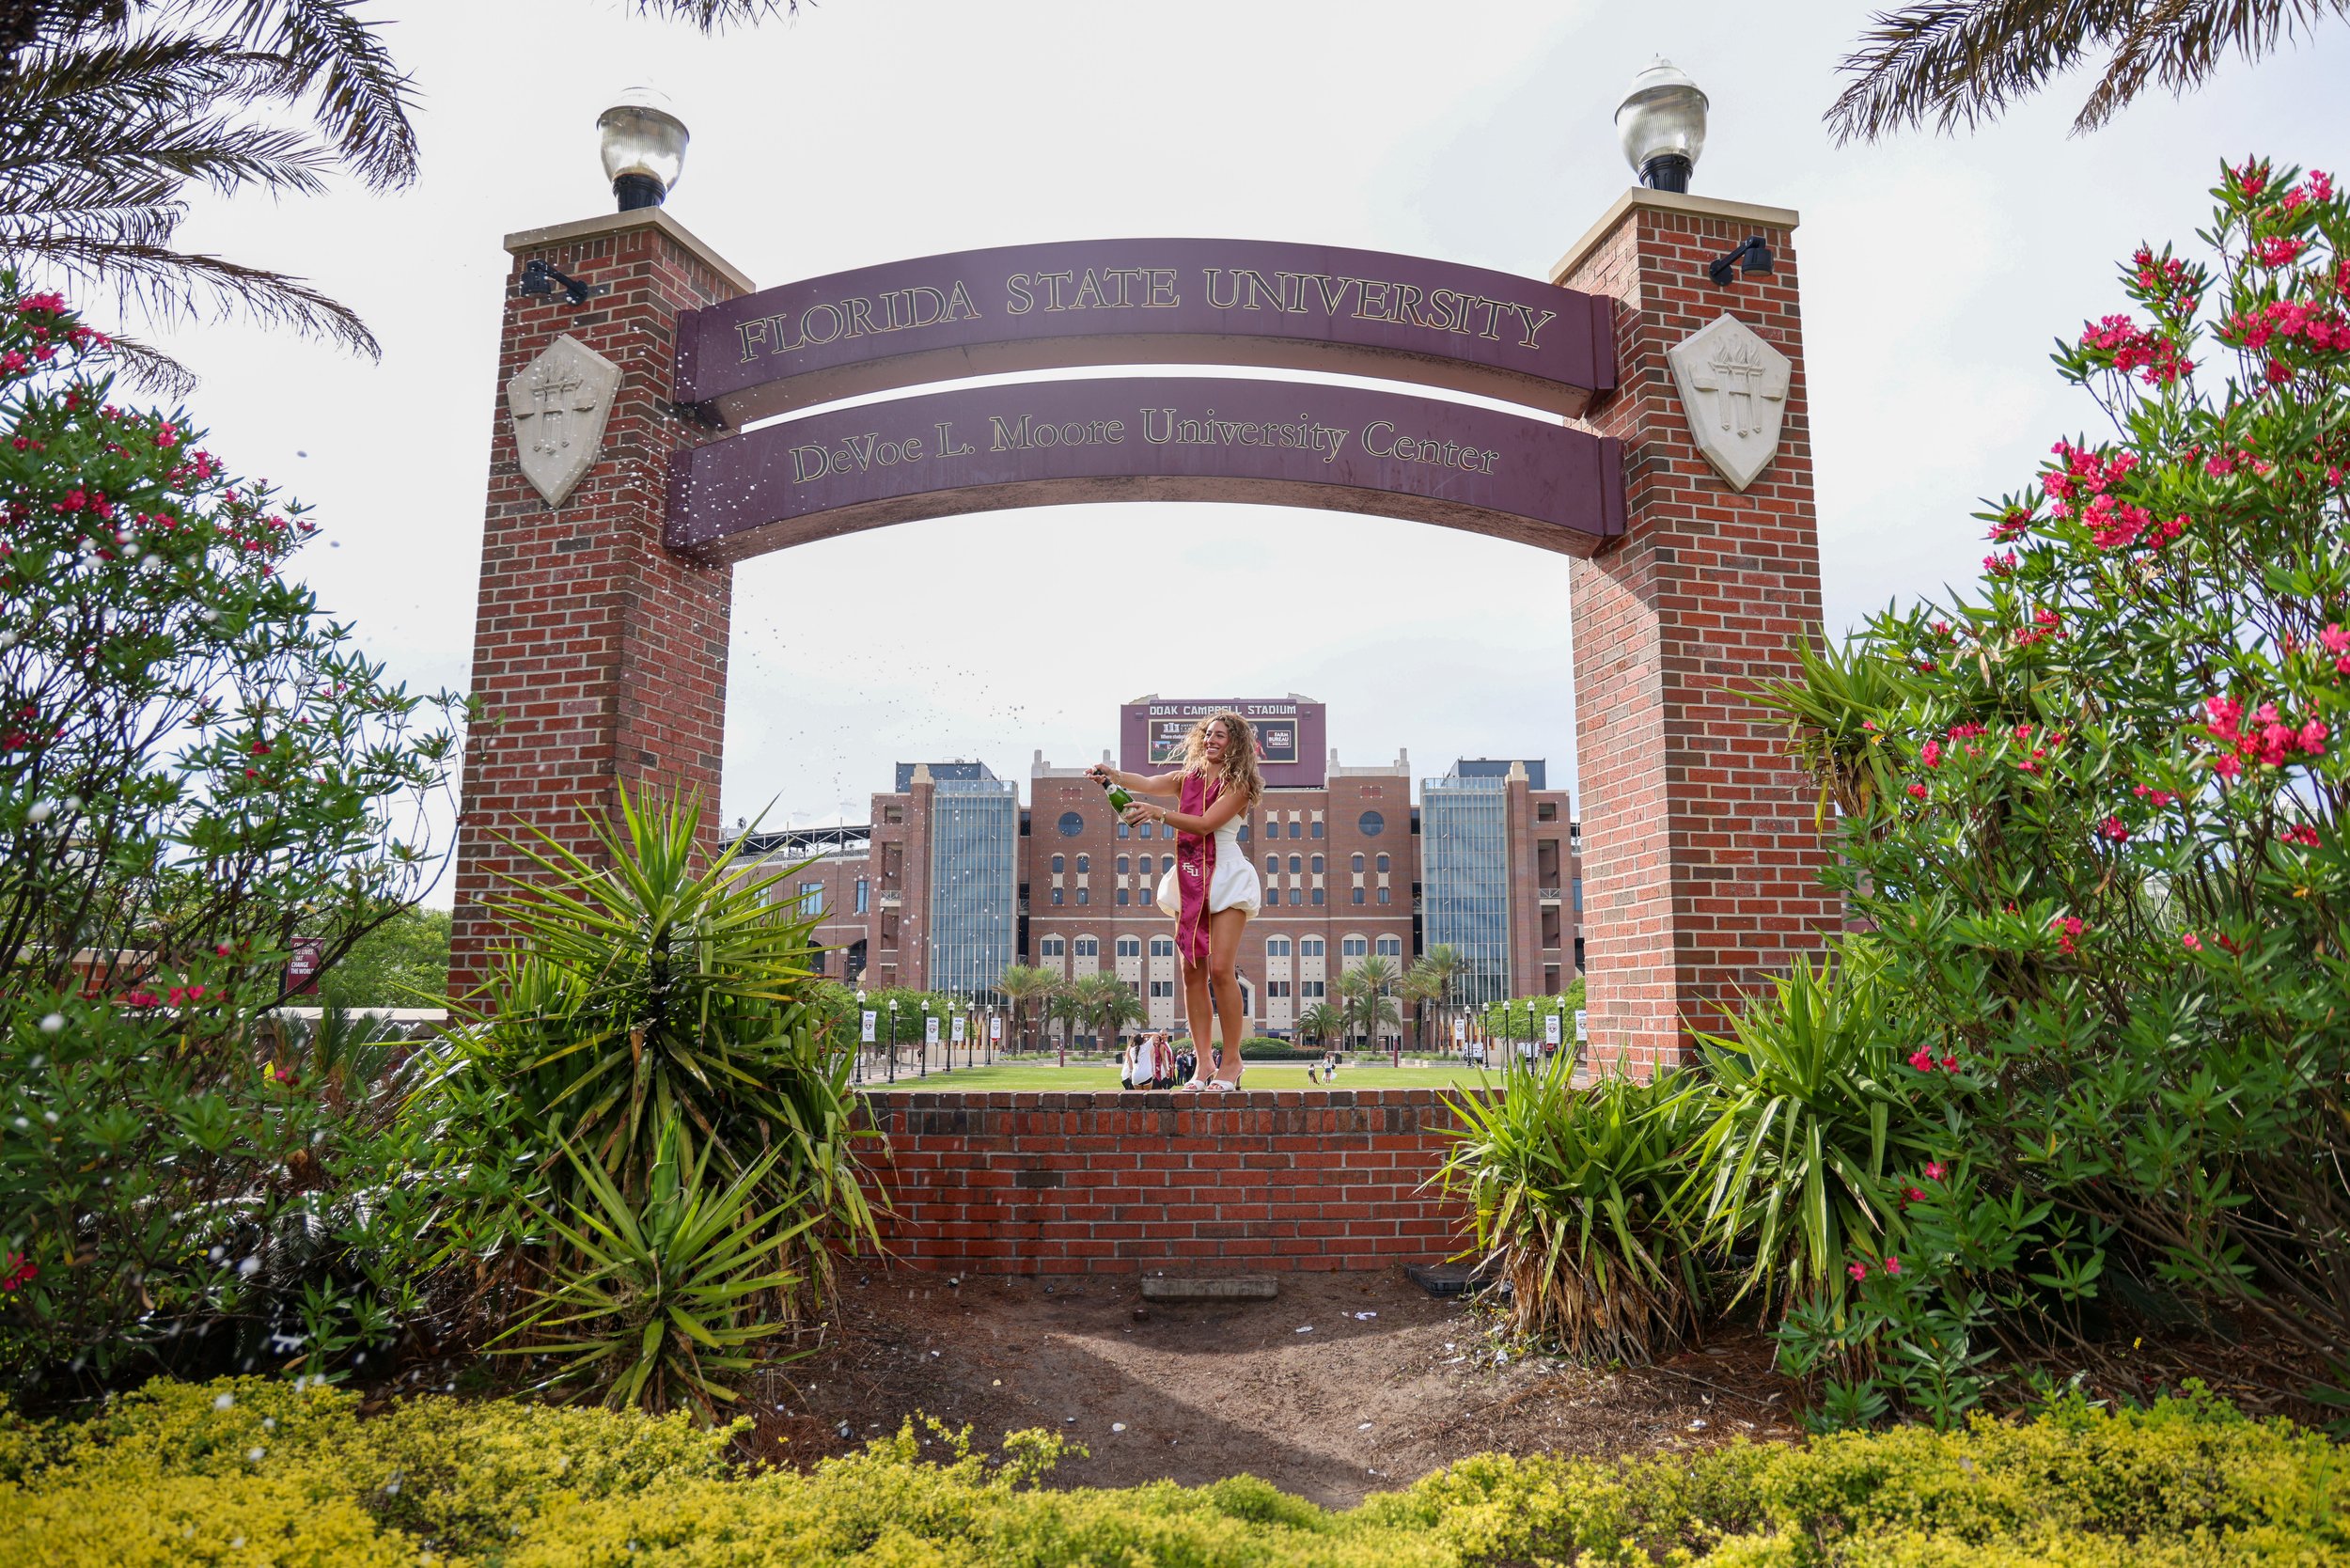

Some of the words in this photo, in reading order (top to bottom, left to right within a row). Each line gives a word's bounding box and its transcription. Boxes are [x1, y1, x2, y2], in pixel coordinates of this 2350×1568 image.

[734, 280, 982, 364] FLORIDA
[1006, 267, 1181, 315] STATE
[1202, 267, 1557, 351] UNIVERSITY
[788, 432, 923, 484] DeVoe
[935, 421, 976, 459] L.
[989, 414, 1125, 452] Moore
[1139, 408, 1350, 464] University
[1360, 420, 1500, 476] Center
[1150, 705, 1178, 715] DOAK
[1247, 705, 1297, 715] STADIUM
[1182, 862, 1198, 876] FSU
